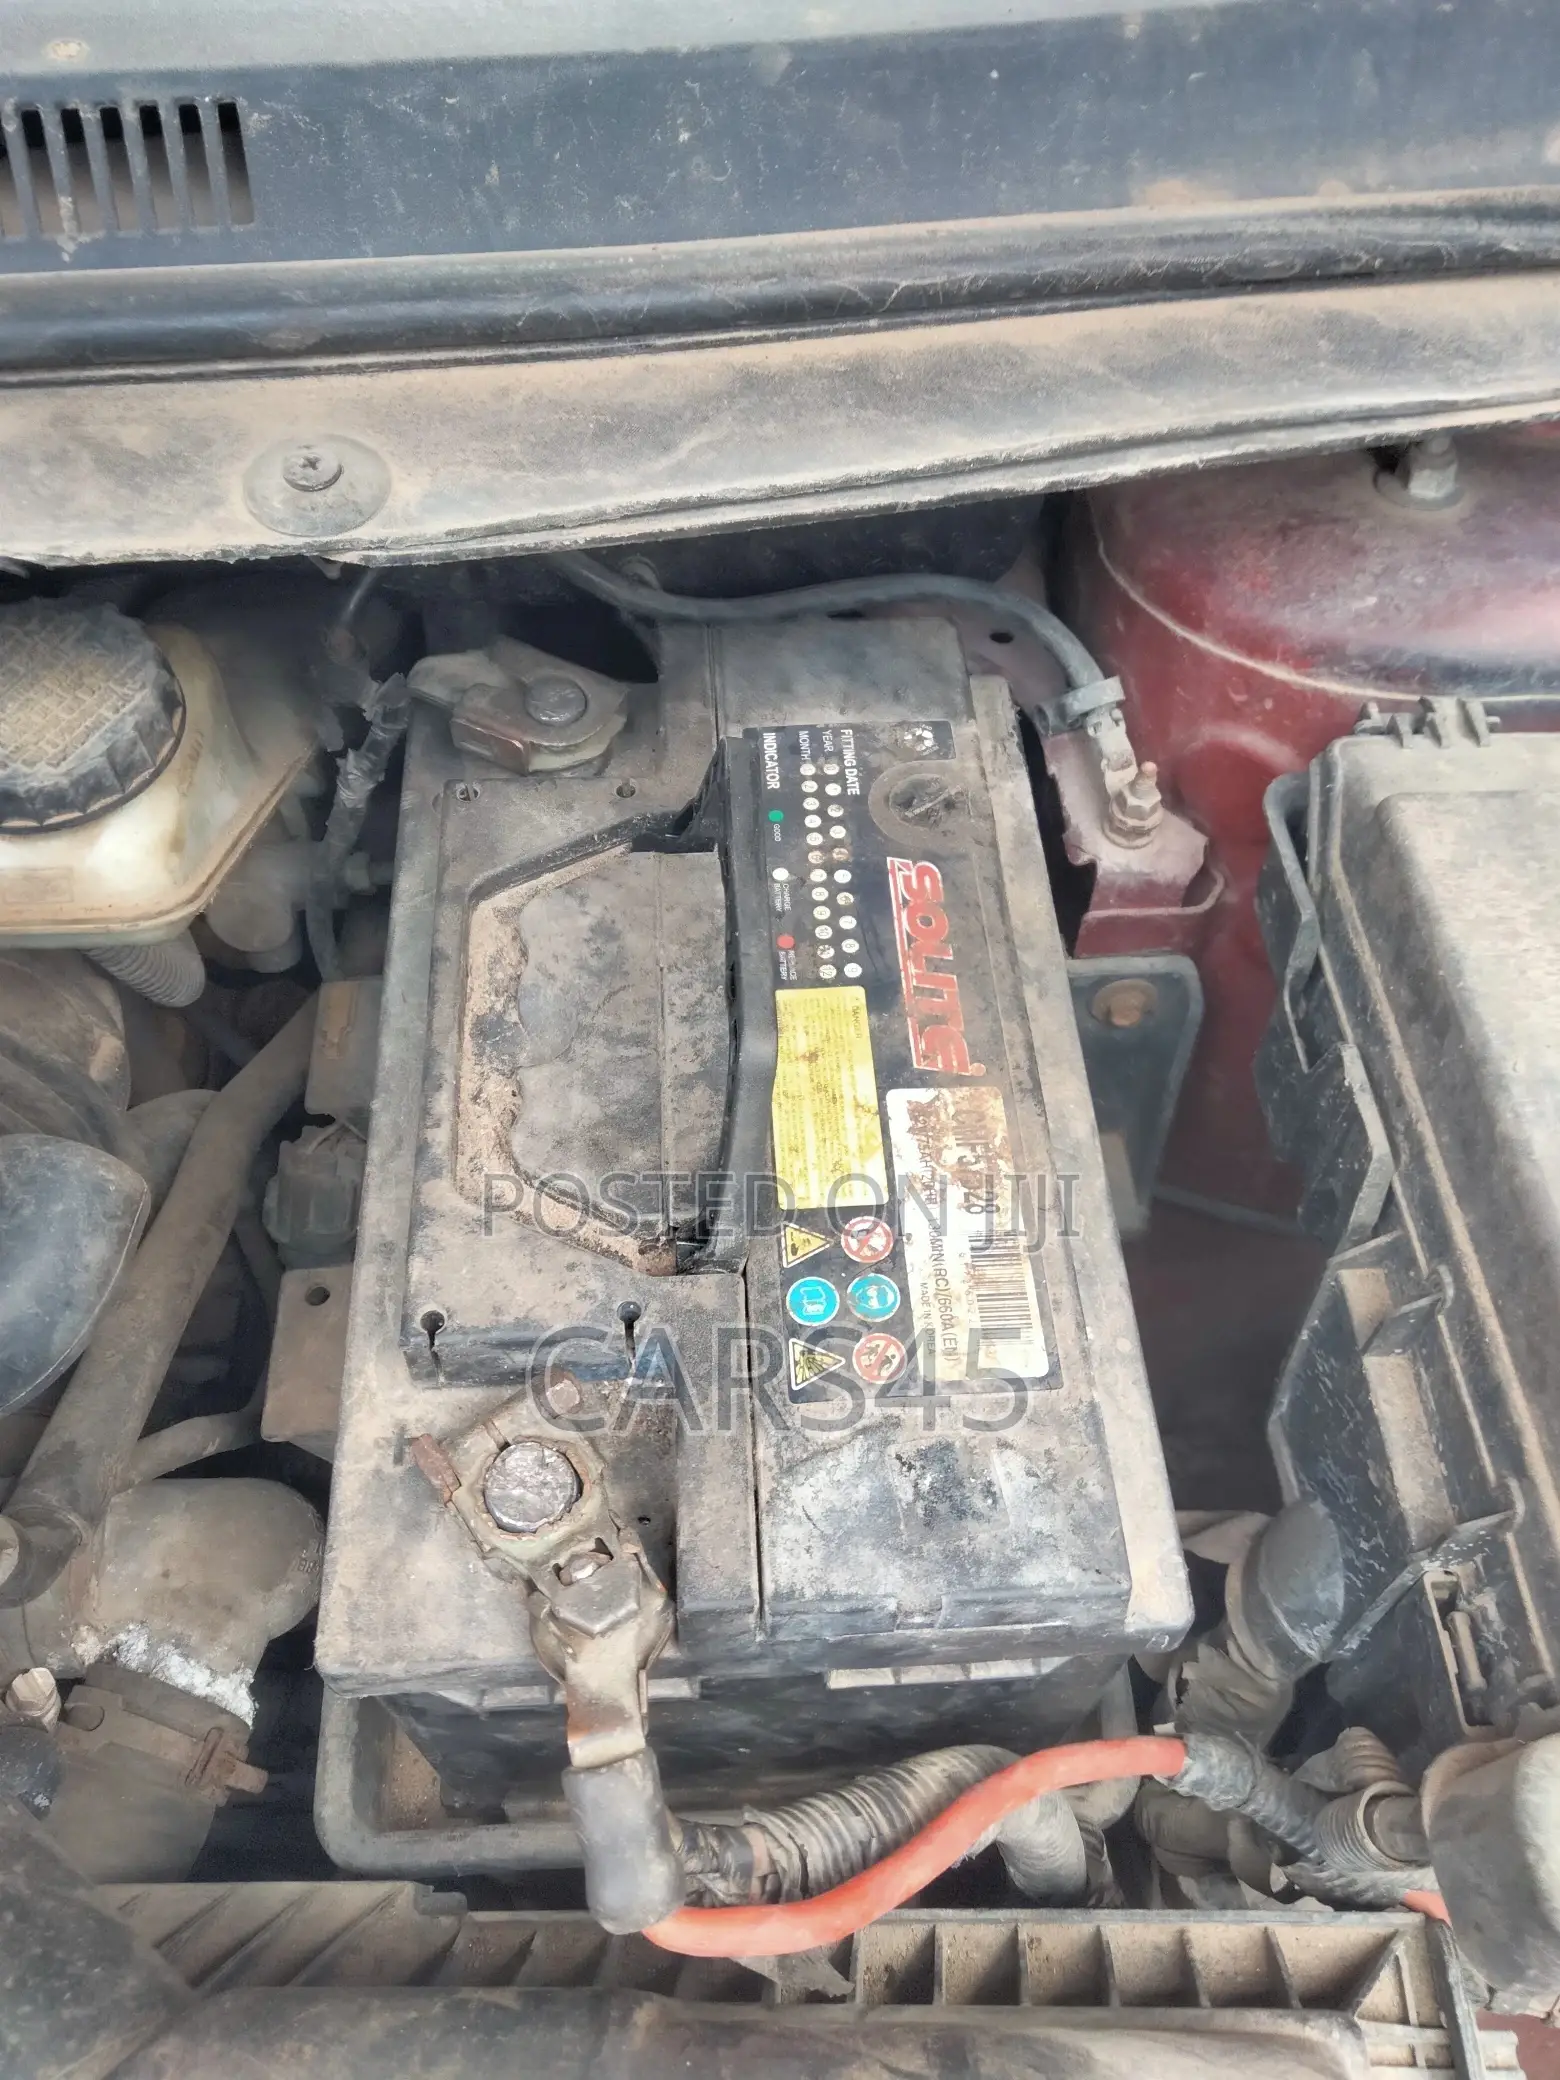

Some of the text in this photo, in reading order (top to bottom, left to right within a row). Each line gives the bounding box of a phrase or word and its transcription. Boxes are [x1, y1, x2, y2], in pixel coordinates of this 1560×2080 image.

[799, 730, 811, 761] MONTH
[822, 729, 834, 753] YEAR
[762, 732, 781, 790] INDICATOR
[840, 729, 860, 796] FITTING DATE
[773, 823, 782, 842] GOOD
[773, 883, 783, 912] BATTERY
[782, 883, 792, 911] CHARGE
[898, 859, 972, 1076] SOLITE
[920, 1282, 930, 1307] MADE
[925, 1321, 937, 1355] KOREA
